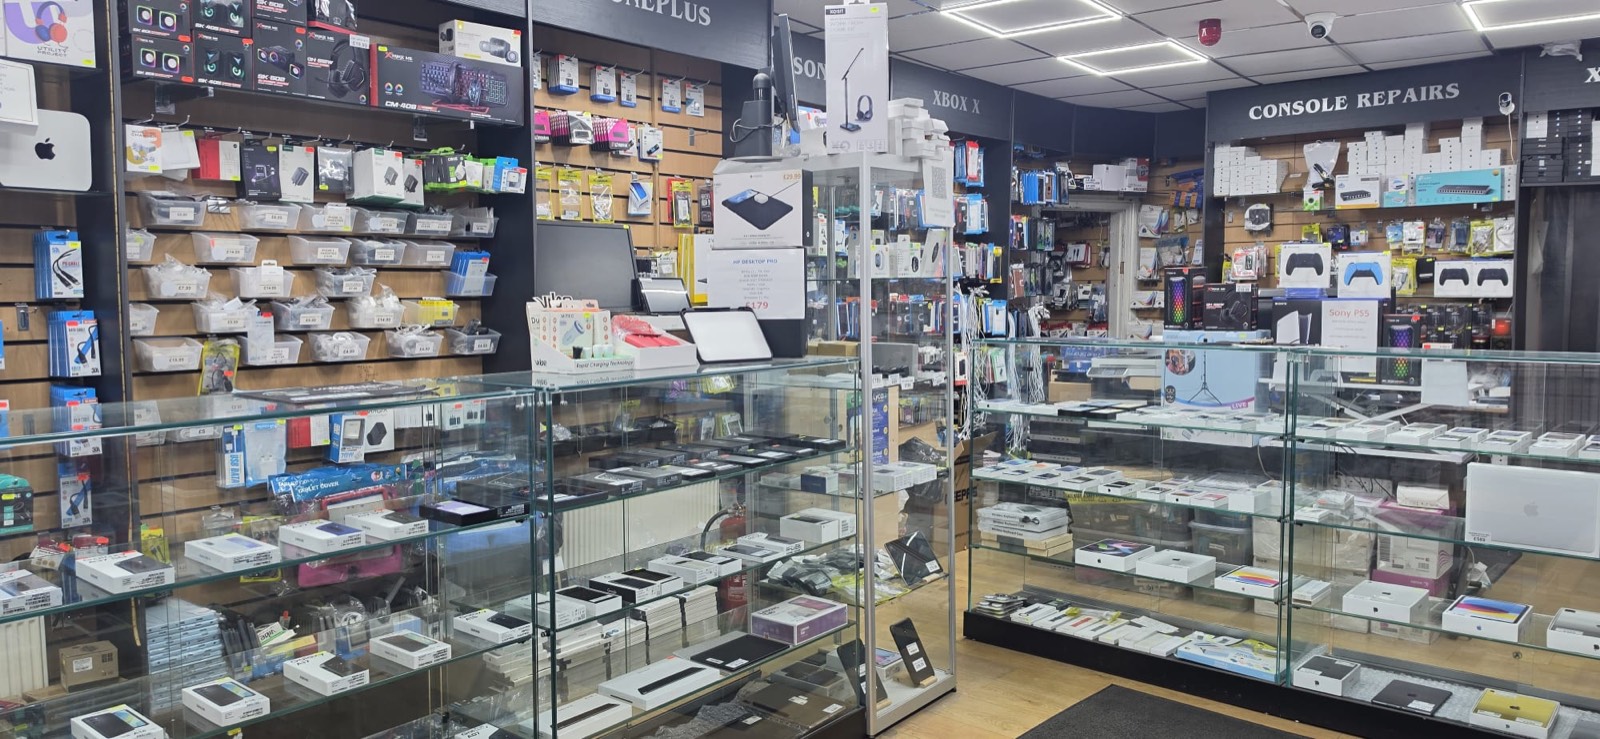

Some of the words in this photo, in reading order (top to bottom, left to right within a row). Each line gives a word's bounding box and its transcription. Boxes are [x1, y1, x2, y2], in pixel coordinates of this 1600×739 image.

[611, 0, 711, 26] NEPLUS
[932, 89, 968, 112] XBOX
[971, 98, 980, 114] X
[1248, 94, 1348, 120] CONSOLE
[1356, 82, 1460, 109] REPAIRS
[1329, 309, 1351, 318] Sony
[1354, 309, 1370, 317] PS5
[230, 454, 240, 466] USB
[320, 481, 340, 489] COVER
